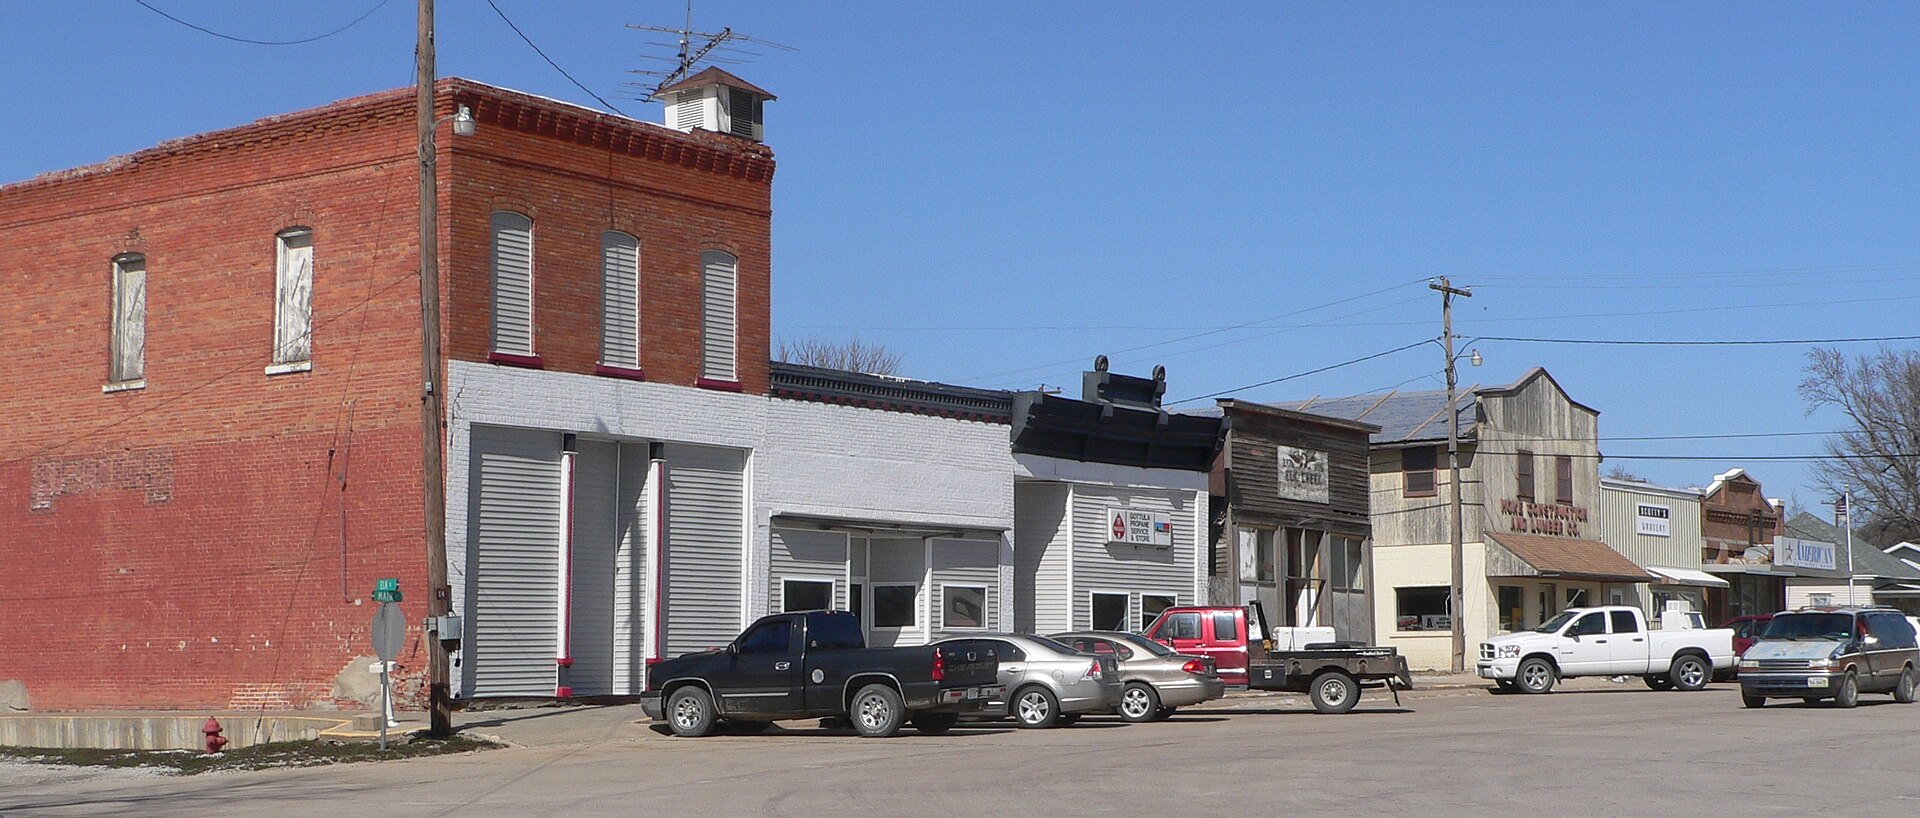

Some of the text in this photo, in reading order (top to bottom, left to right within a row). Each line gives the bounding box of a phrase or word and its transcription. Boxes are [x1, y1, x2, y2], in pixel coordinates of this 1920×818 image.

[1130, 512, 1150, 521] GOTTULA
[1527, 502, 1588, 523] CONSTRUCTION
[1130, 520, 1150, 528] PROPANE
[1511, 516, 1528, 533] AND
[1531, 518, 1564, 536] LUMBER
[1642, 522, 1665, 532] GROCERY
[1793, 540, 1833, 564] AMERICAN
[380, 580, 388, 590] ELK
